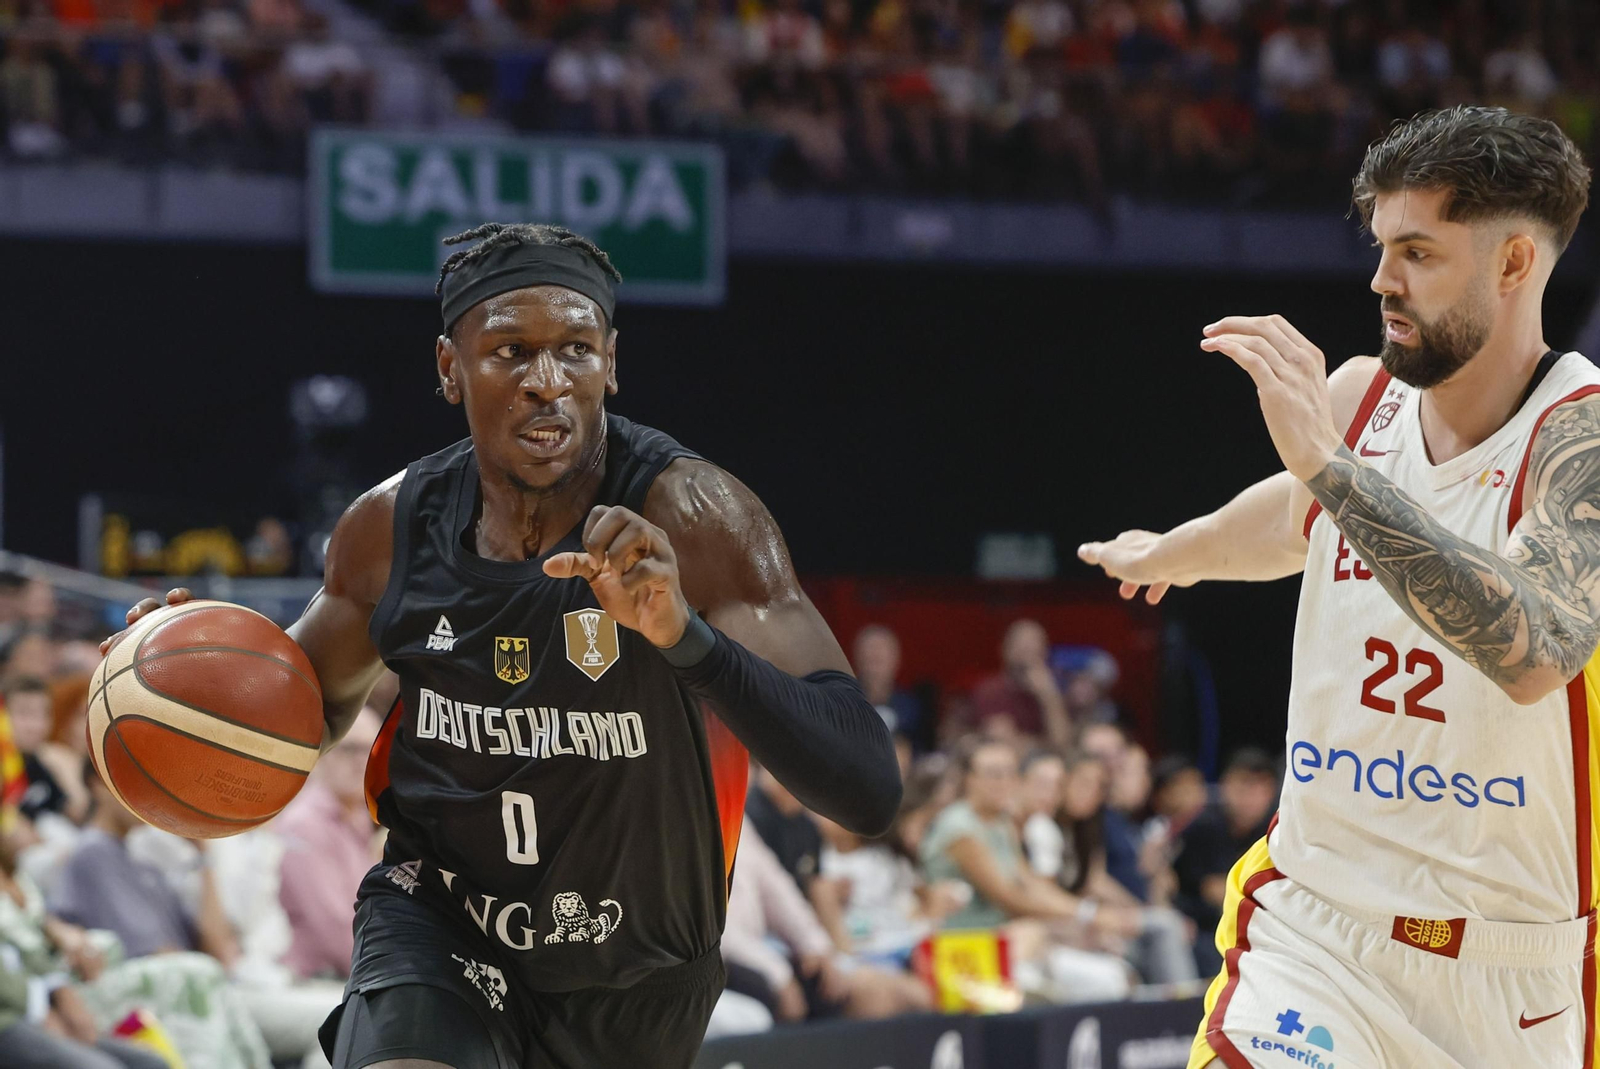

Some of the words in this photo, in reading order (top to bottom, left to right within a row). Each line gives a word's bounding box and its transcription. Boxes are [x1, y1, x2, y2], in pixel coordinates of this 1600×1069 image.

[340, 144, 692, 232] SALIDA
[426, 633, 459, 651] PEAK
[1360, 636, 1447, 723] 22
[417, 688, 648, 760] DEUTSCHLAND
[1291, 741, 1526, 808] endesa
[501, 790, 539, 865] 0
[385, 865, 421, 894] PEAK
